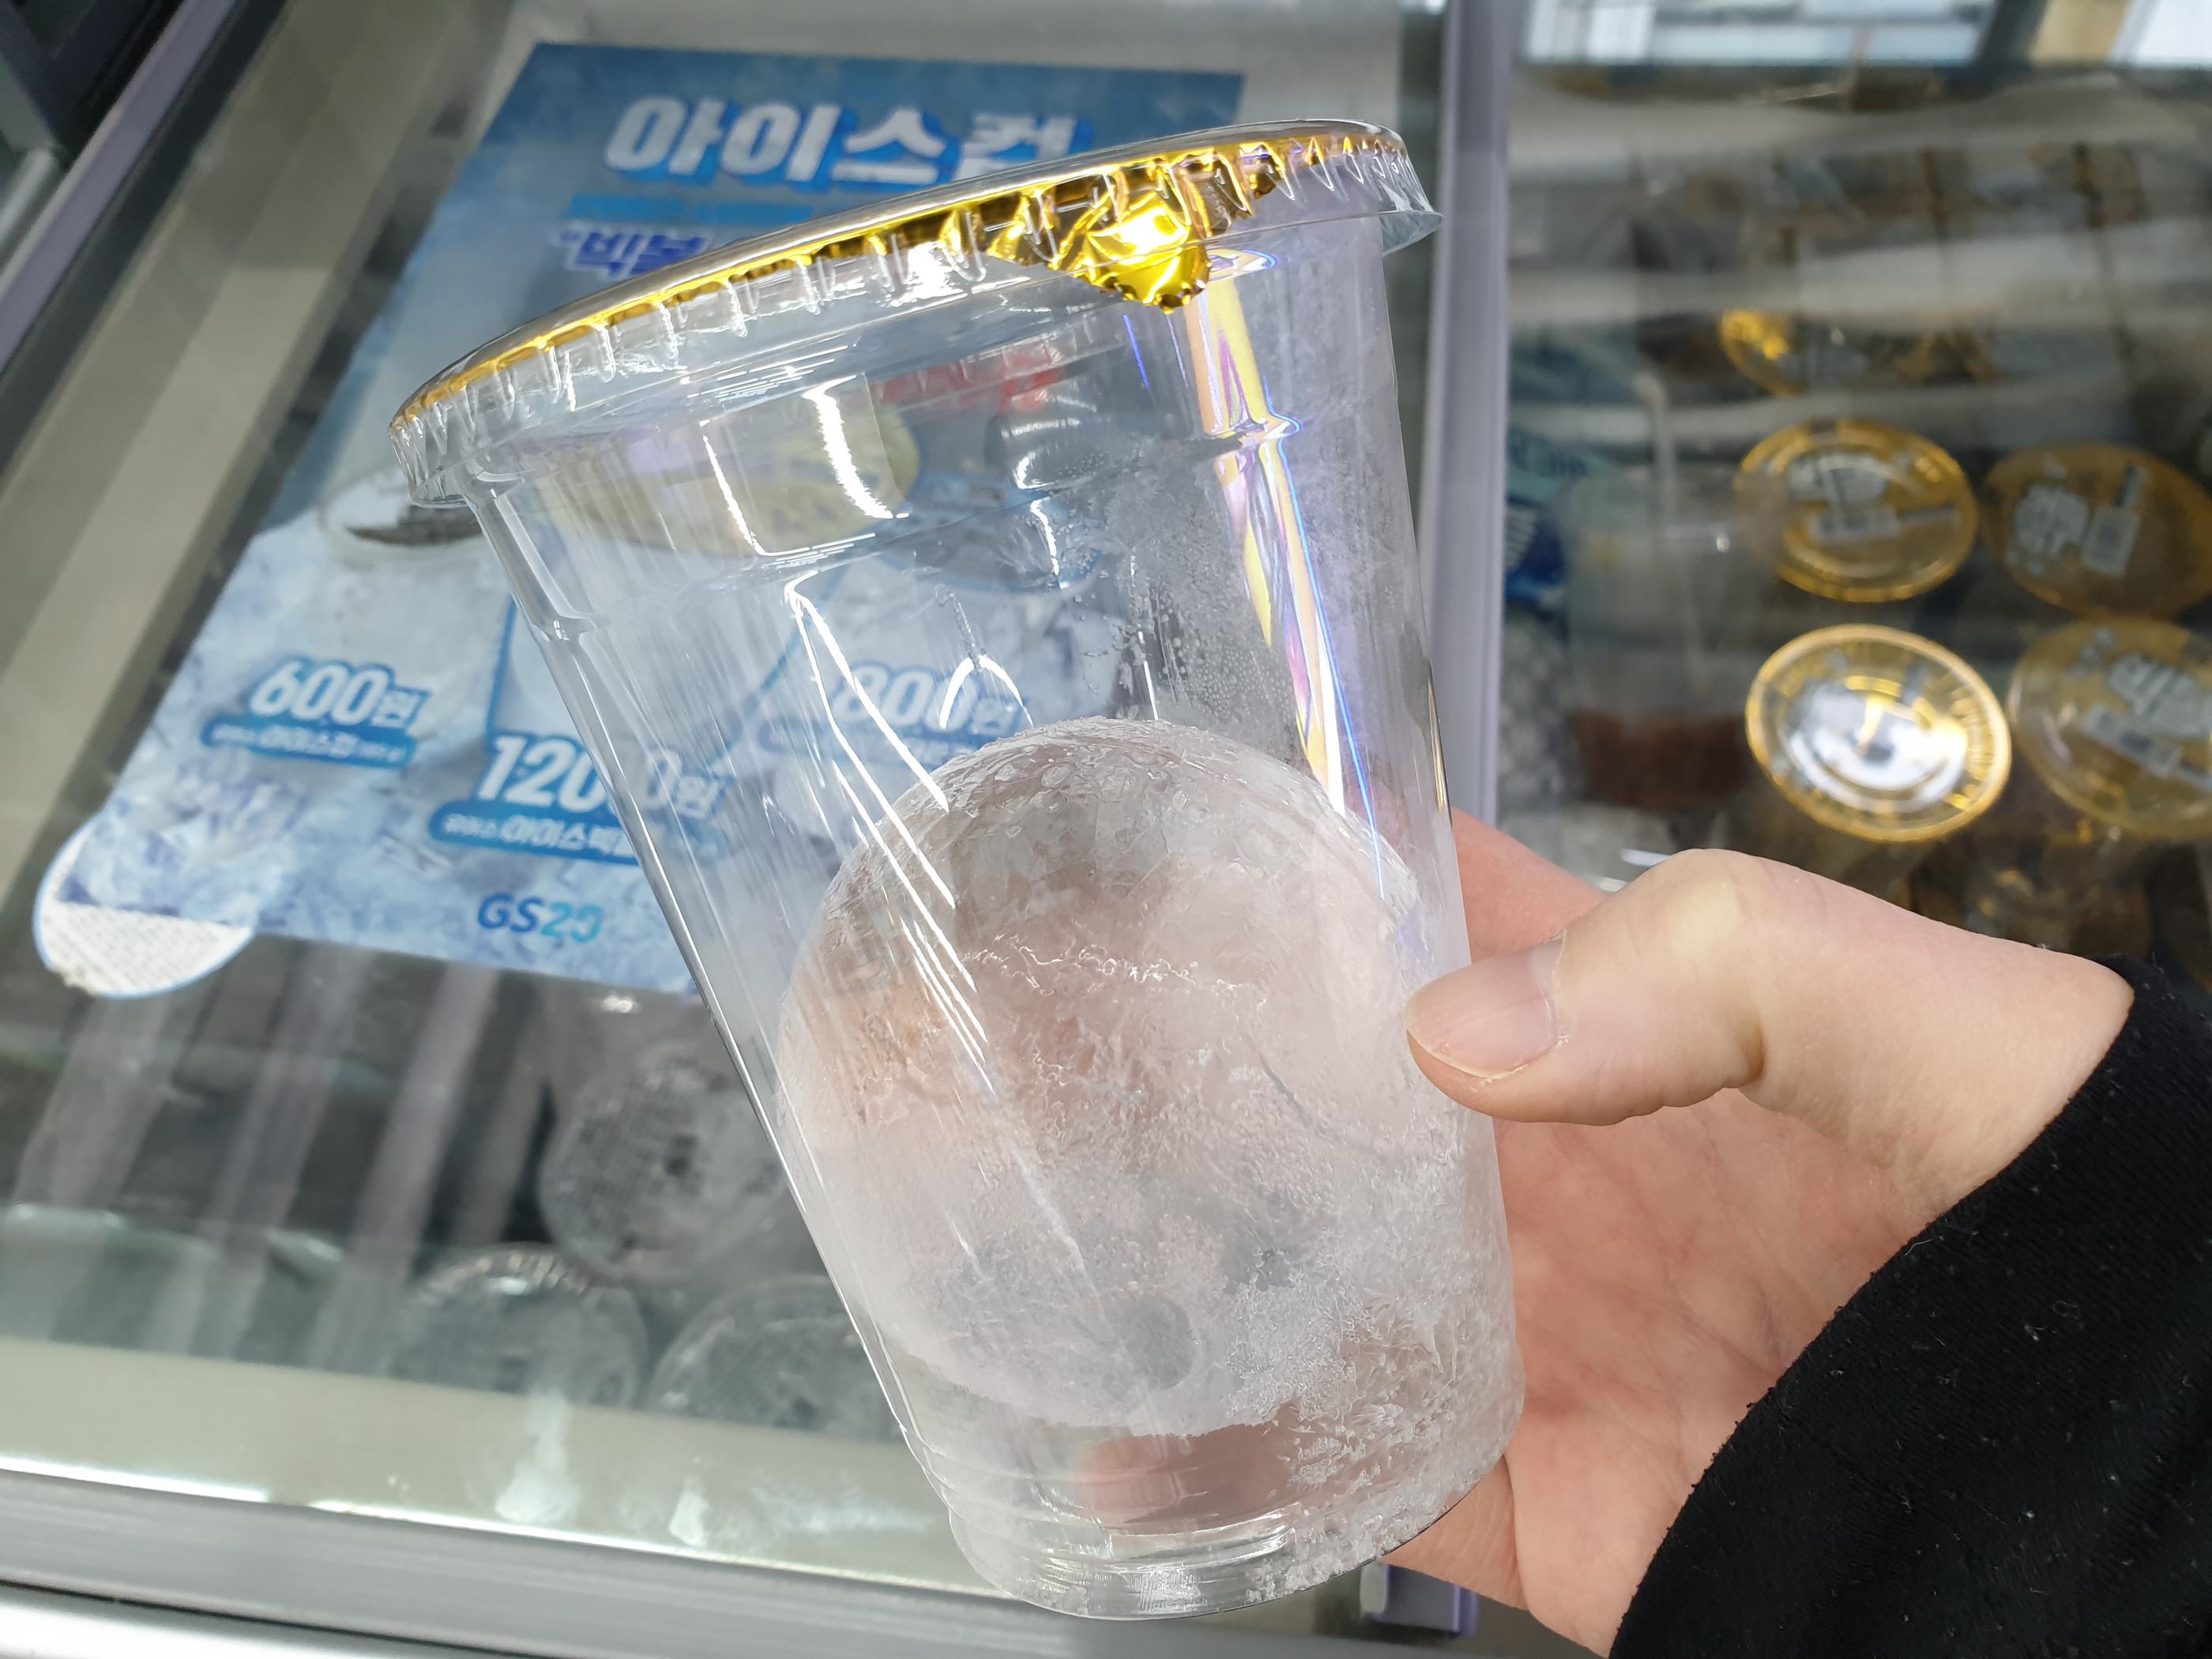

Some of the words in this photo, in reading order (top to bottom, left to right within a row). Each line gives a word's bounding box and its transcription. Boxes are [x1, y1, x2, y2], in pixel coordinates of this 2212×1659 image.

[605, 96, 1079, 184] 아이스컵
[249, 660, 419, 728] 600원
[477, 891, 604, 944] GS25
